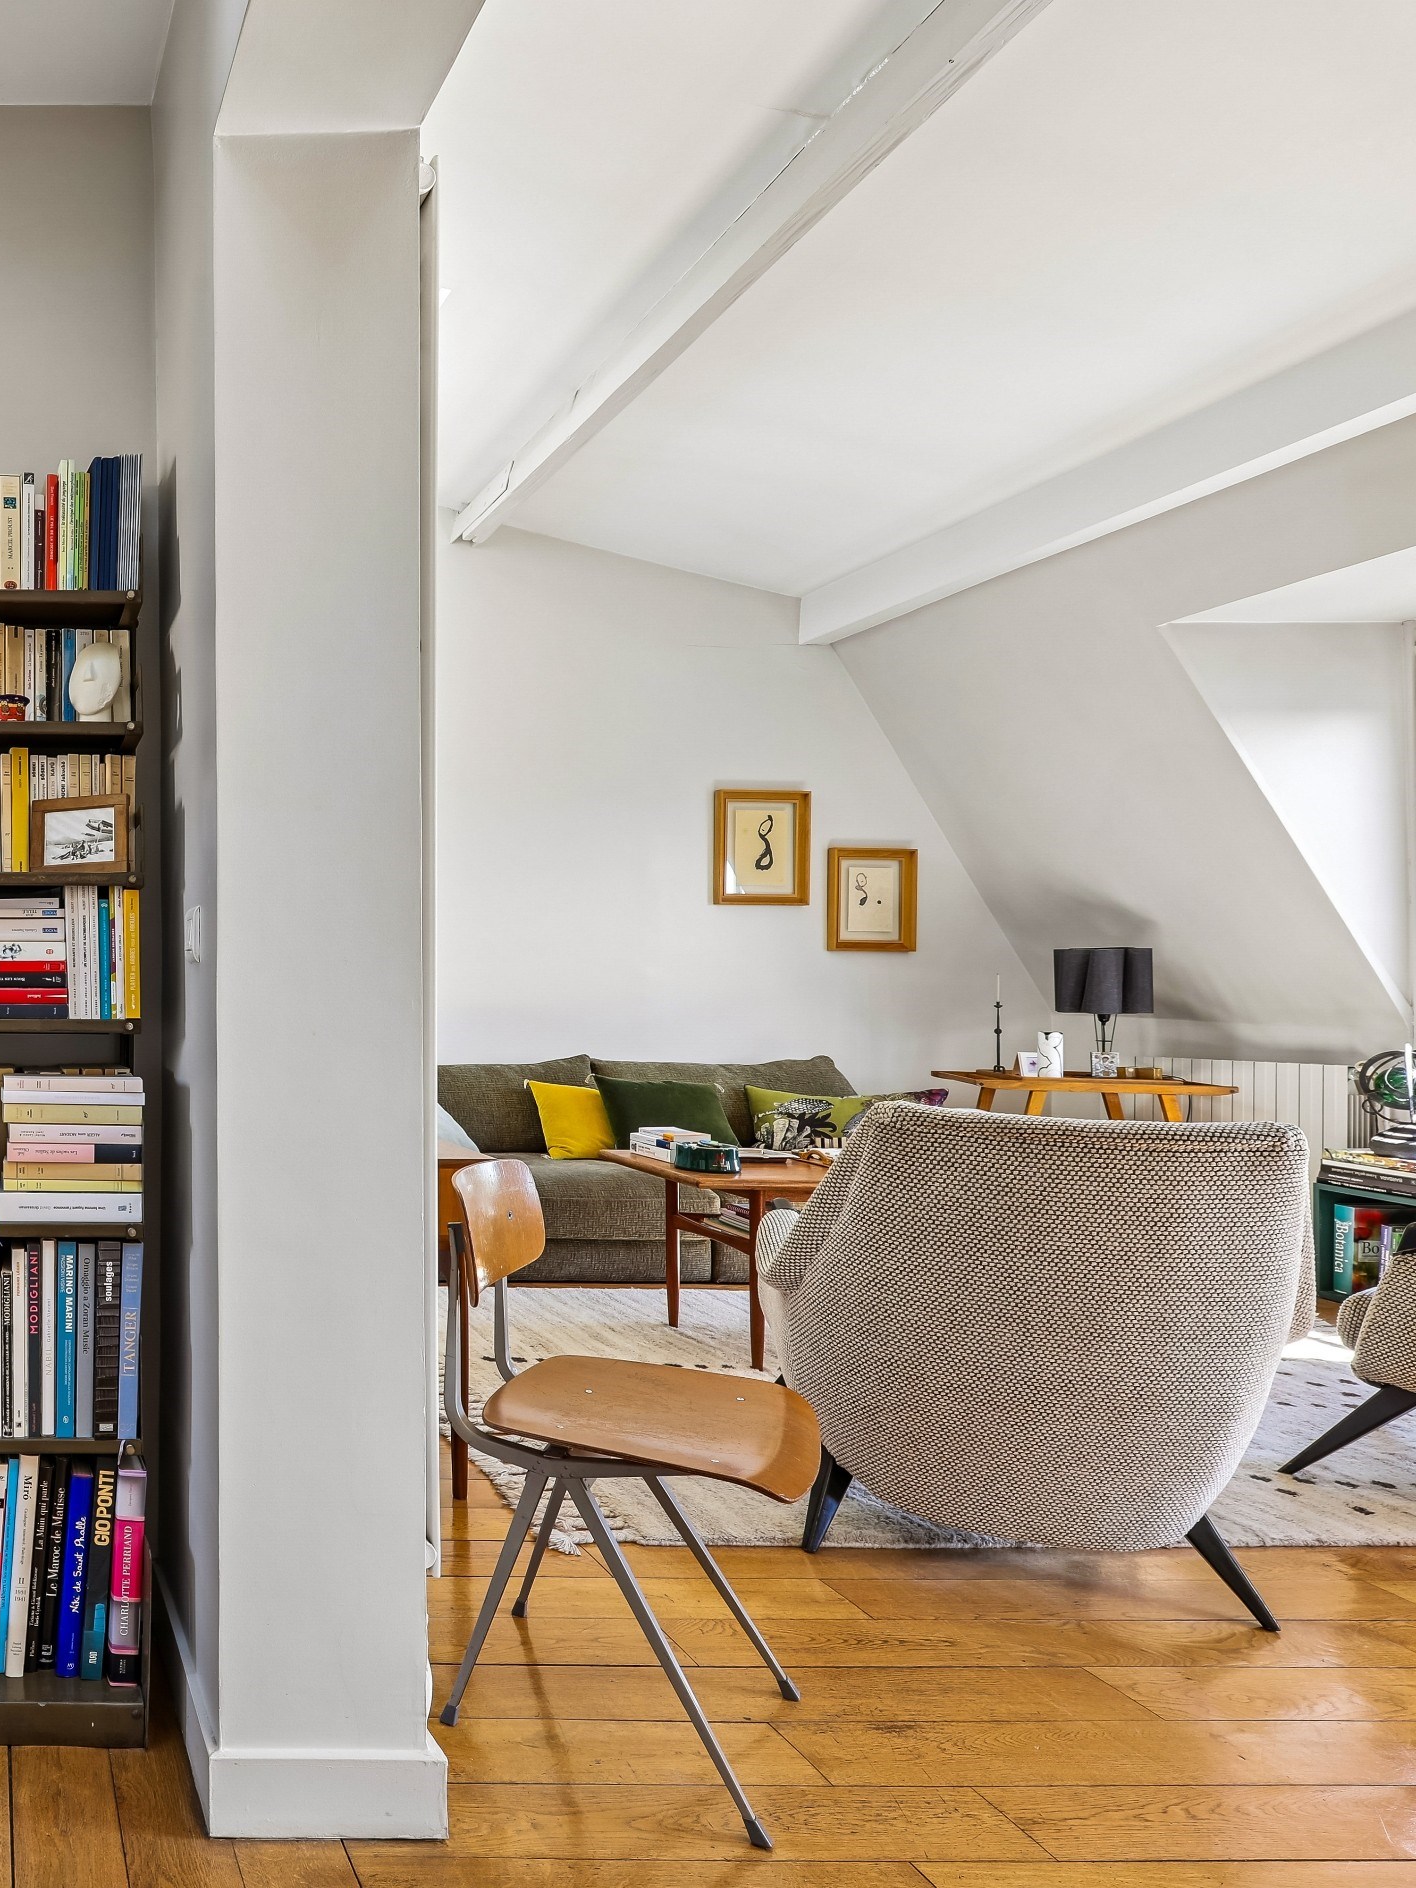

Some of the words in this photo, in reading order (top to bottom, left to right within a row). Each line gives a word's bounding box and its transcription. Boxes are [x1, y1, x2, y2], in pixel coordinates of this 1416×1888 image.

[1334, 1218, 1349, 1274] Botanica
[65, 1254, 74, 1295] MARINO
[81, 1257, 91, 1295] Omaggio
[102, 1262, 114, 1302] soulages
[3, 1277, 11, 1327] MODIGLIANI
[29, 1251, 39, 1335] MODIGLIANI
[65, 1297, 74, 1332] MARINI
[82, 1302, 90, 1328] Zoran
[82, 1329, 90, 1355] Music
[123, 1312, 137, 1374] TANGER
[45, 1347, 53, 1376] NABIL
[22, 1474, 34, 1500] Miró
[40, 1481, 49, 1503] parle
[95, 1470, 114, 1519] PONTI
[39, 1505, 48, 1516] qui
[52, 1487, 66, 1528] Matisse
[37, 1518, 46, 1539] Main
[50, 1531, 62, 1543] de
[75, 1517, 87, 1549] Phalle
[92, 1520, 110, 1547] GIO
[36, 1540, 44, 1551] La
[120, 1526, 132, 1577] PERRIAND
[47, 1546, 61, 1581] Maroc
[72, 1552, 85, 1578] Saint
[46, 1583, 58, 1598] Le
[71, 1581, 82, 1593] de
[69, 1597, 80, 1614] Niki
[118, 1578, 130, 1637] CHARLOTTE
